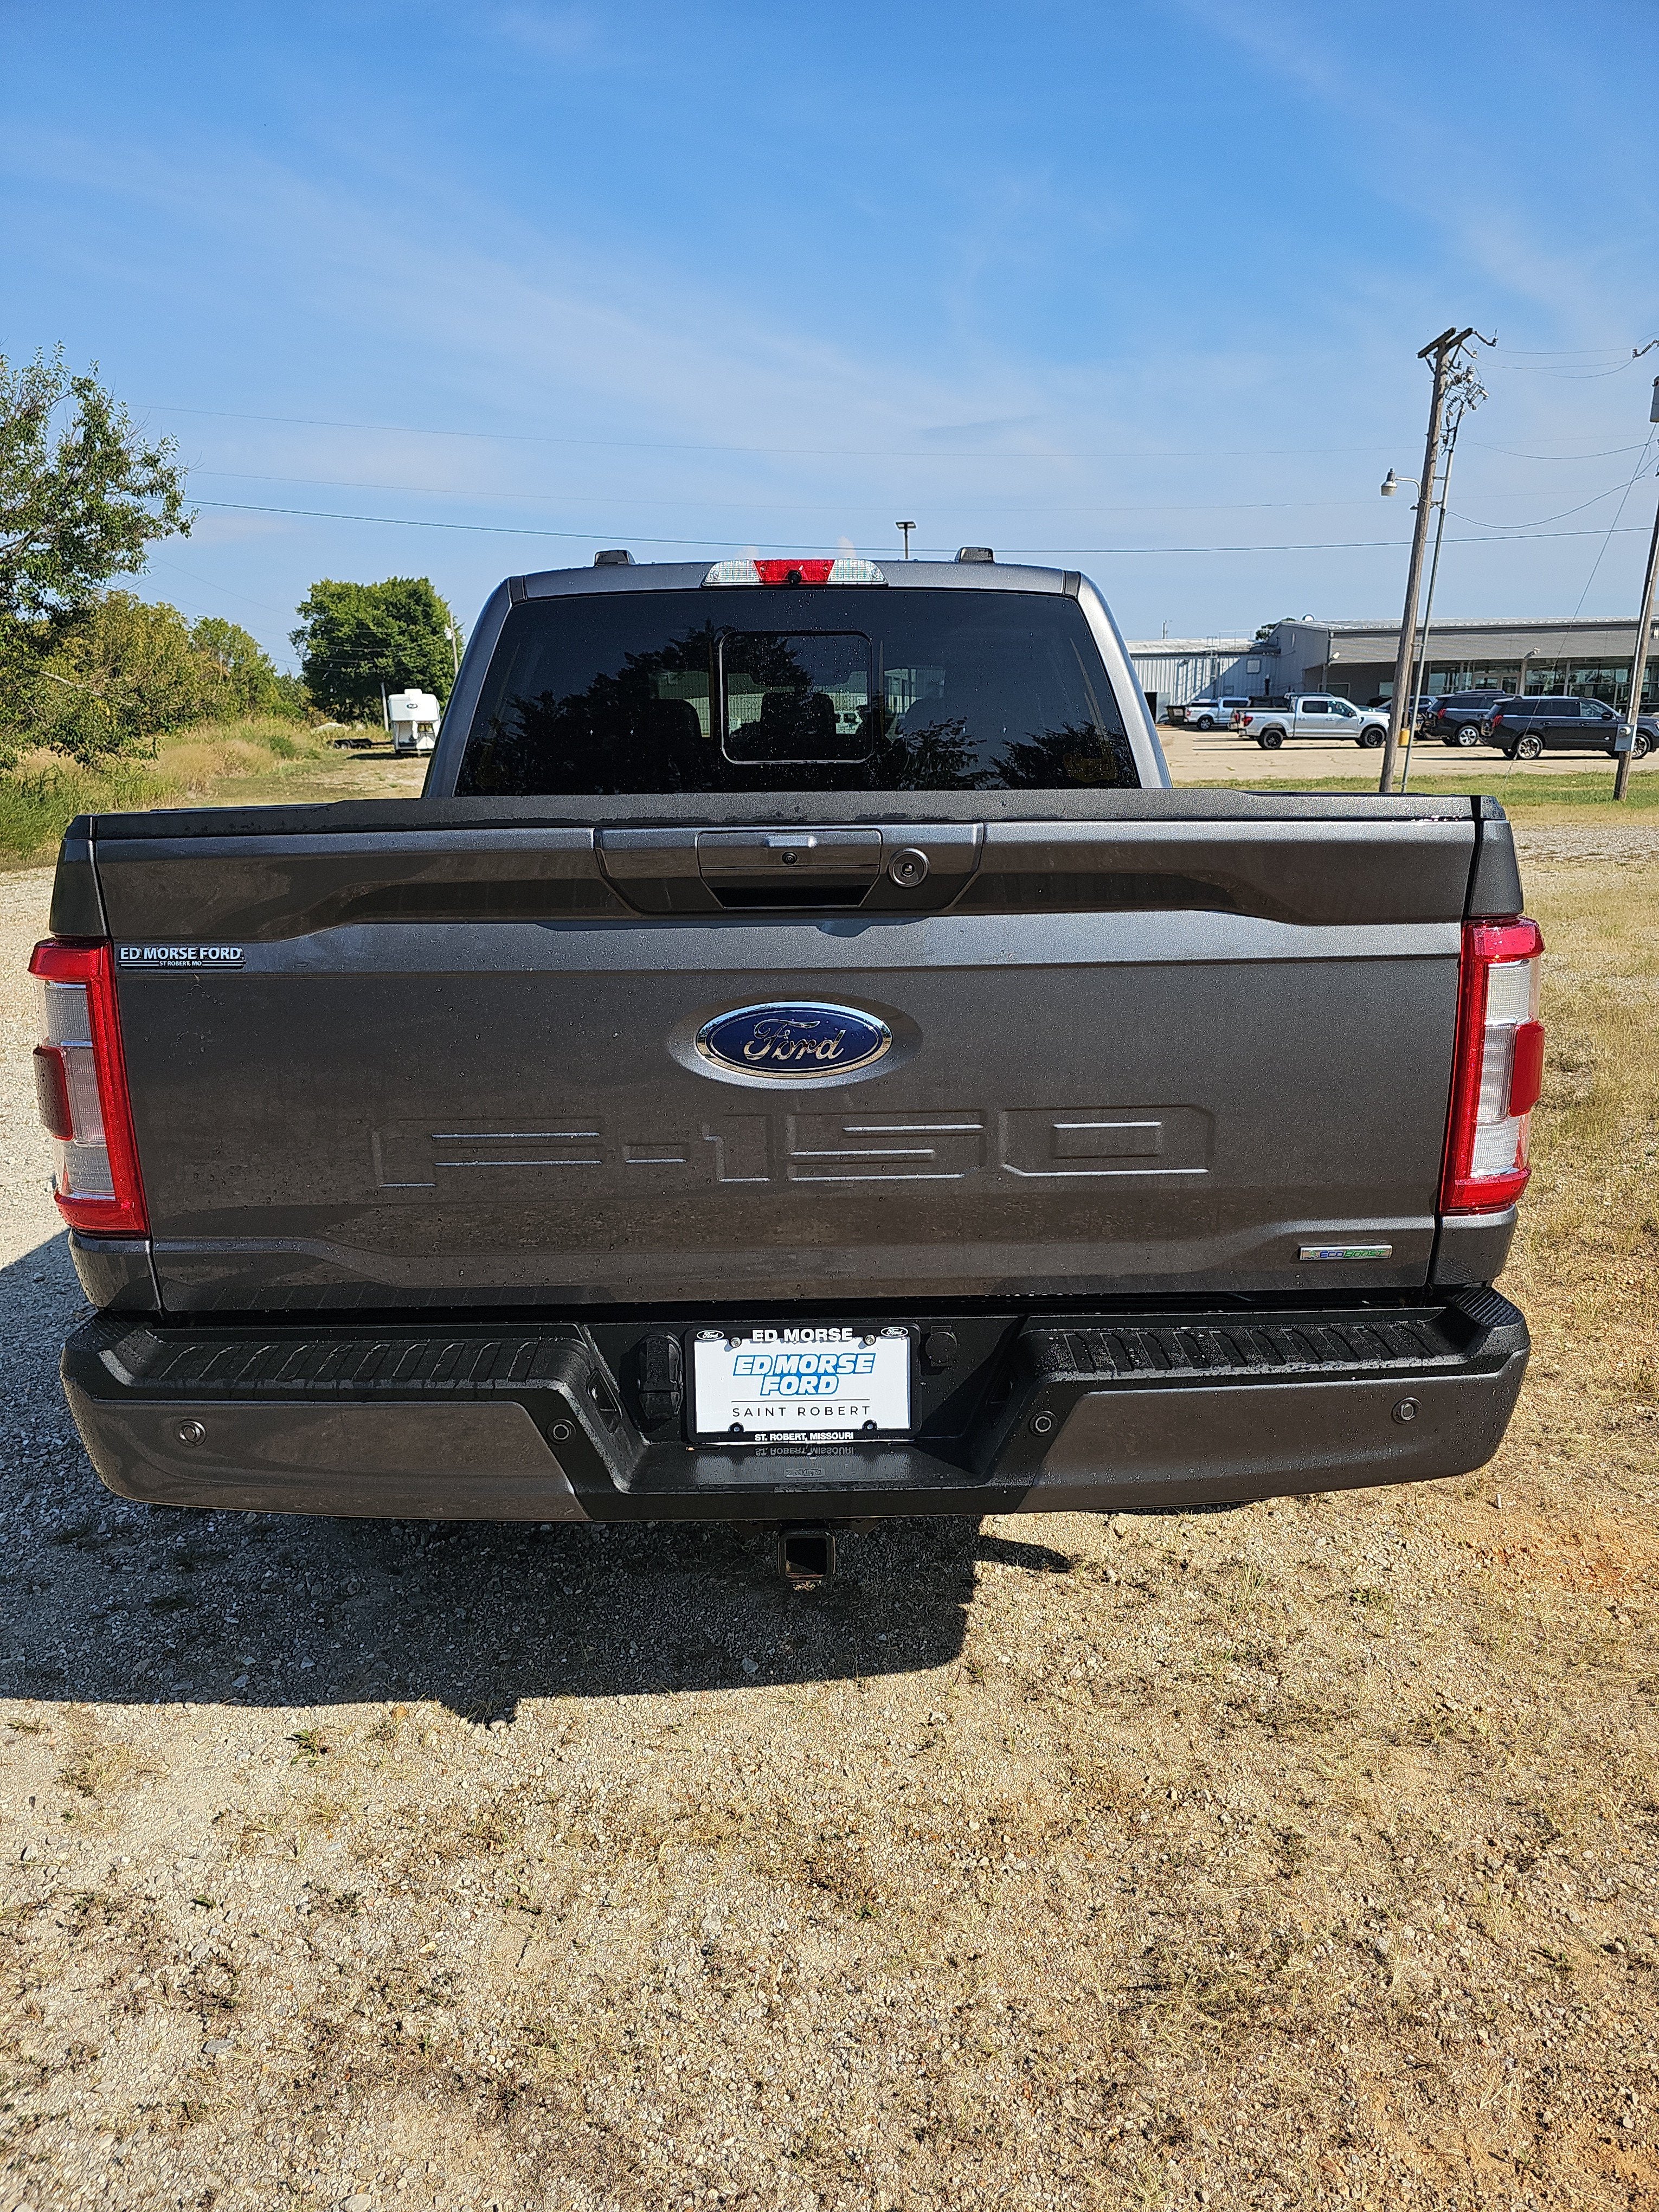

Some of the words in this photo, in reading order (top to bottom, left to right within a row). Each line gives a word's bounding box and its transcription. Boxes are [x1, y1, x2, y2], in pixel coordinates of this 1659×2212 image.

[120, 947, 140, 960] ED
[144, 947, 197, 960] MORSE
[200, 947, 241, 960] FORD
[743, 1019, 845, 1060] Ford
[371, 1103, 1216, 1189] F-150
[752, 1329, 778, 1342] ED
[783, 1328, 853, 1342] MORSE
[733, 1355, 773, 1376] ED
[773, 1353, 876, 1376] MORSE
[760, 1374, 839, 1396] FORD
[732, 1406, 787, 1417] SAINT
[798, 1406, 870, 1416] ROBERT
[769, 1433, 808, 1442] ROBERT,
[809, 1432, 854, 1440] MISSOURI
